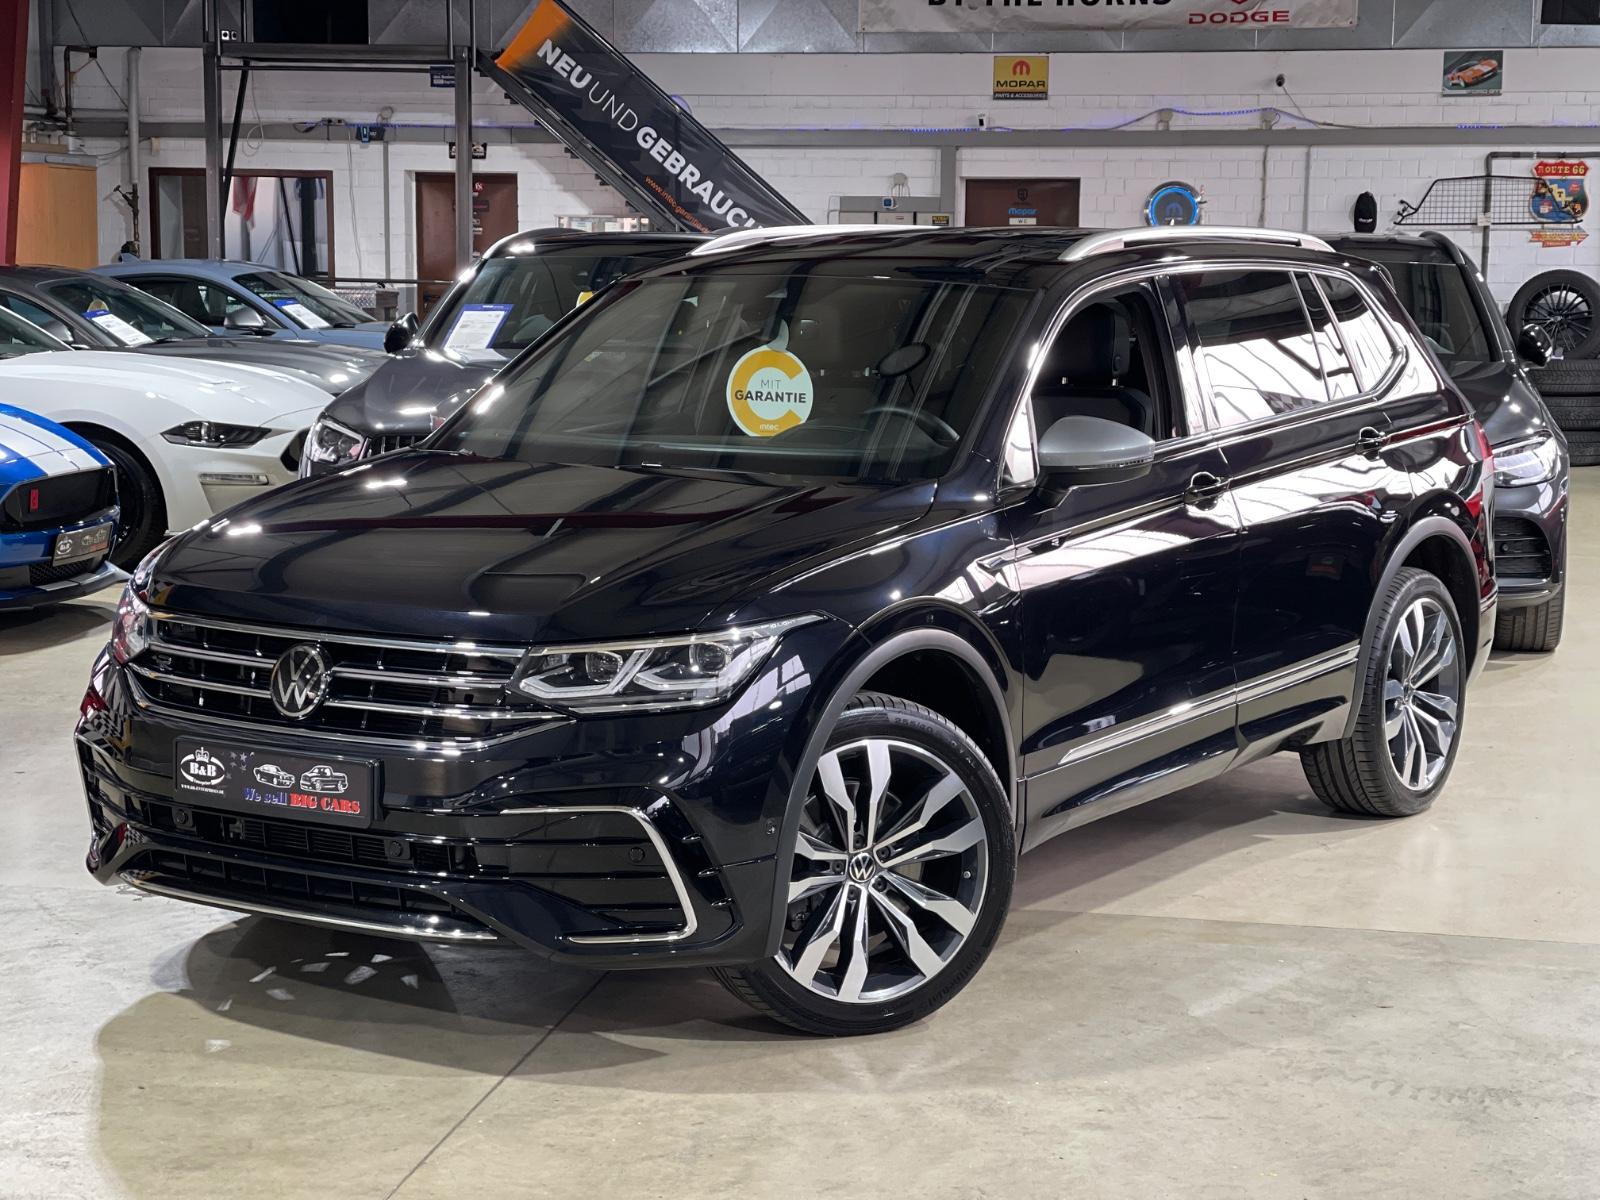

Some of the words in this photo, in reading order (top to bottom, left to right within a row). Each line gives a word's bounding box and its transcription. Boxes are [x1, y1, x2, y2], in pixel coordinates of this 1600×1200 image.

[1189, 10, 1290, 25] DODGE
[537, 38, 593, 89] NEU
[588, 81, 638, 131] UND
[996, 80, 1046, 88] MOPAR
[1537, 165, 1570, 174] ROUTE
[1572, 165, 1585, 174] 66
[760, 379, 781, 389] MIT
[734, 390, 807, 404] GARANTIE
[189, 762, 217, 777] B&B
[243, 786, 262, 802] We
[263, 791, 288, 806] sell
[289, 793, 318, 809] BIG
[320, 796, 361, 814] CARS
